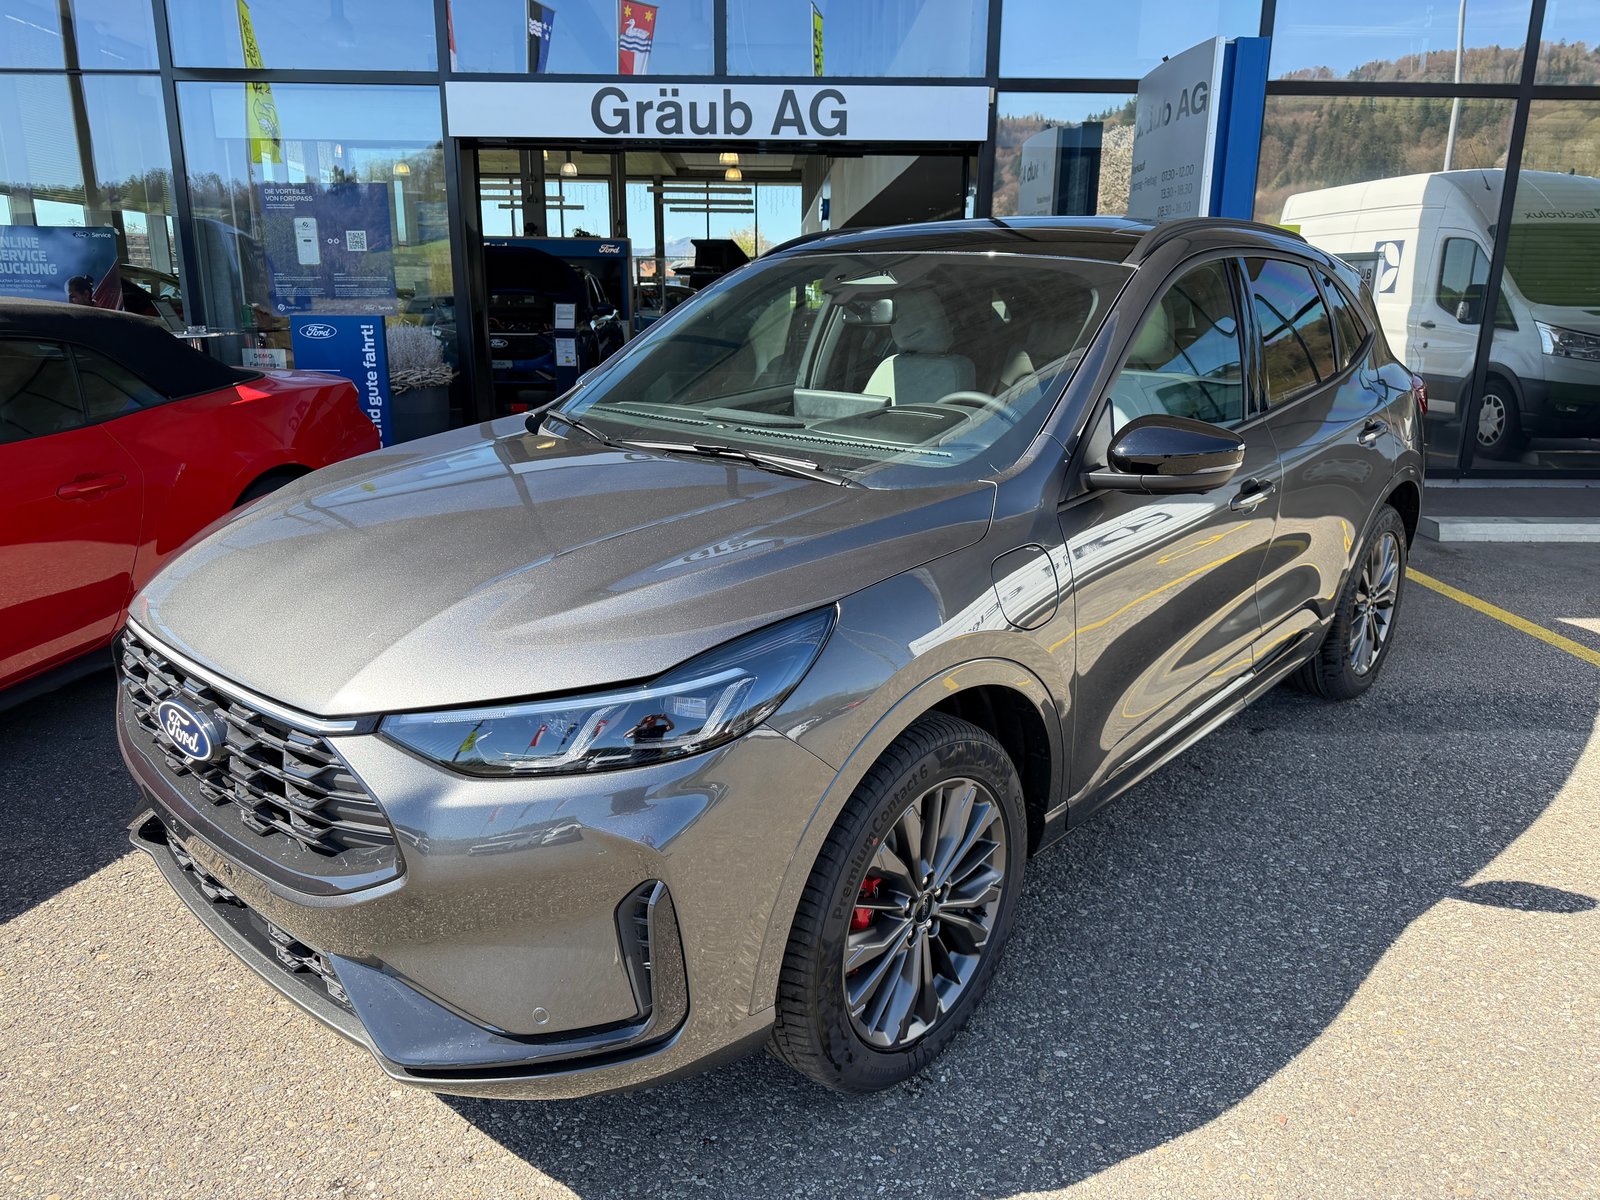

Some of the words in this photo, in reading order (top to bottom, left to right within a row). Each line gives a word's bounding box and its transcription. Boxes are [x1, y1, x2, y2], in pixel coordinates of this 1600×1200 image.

[591, 87, 753, 135] Gräub
[771, 88, 848, 137] AG
[1176, 82, 1207, 121] AG
[0, 236, 40, 249] NLINE
[0, 249, 47, 262] ERVICE
[598, 244, 620, 254] Ford
[360, 324, 377, 369] fahrt!
[366, 371, 382, 406] gute
[166, 707, 201, 754] Ford
[919, 763, 929, 780] 6
